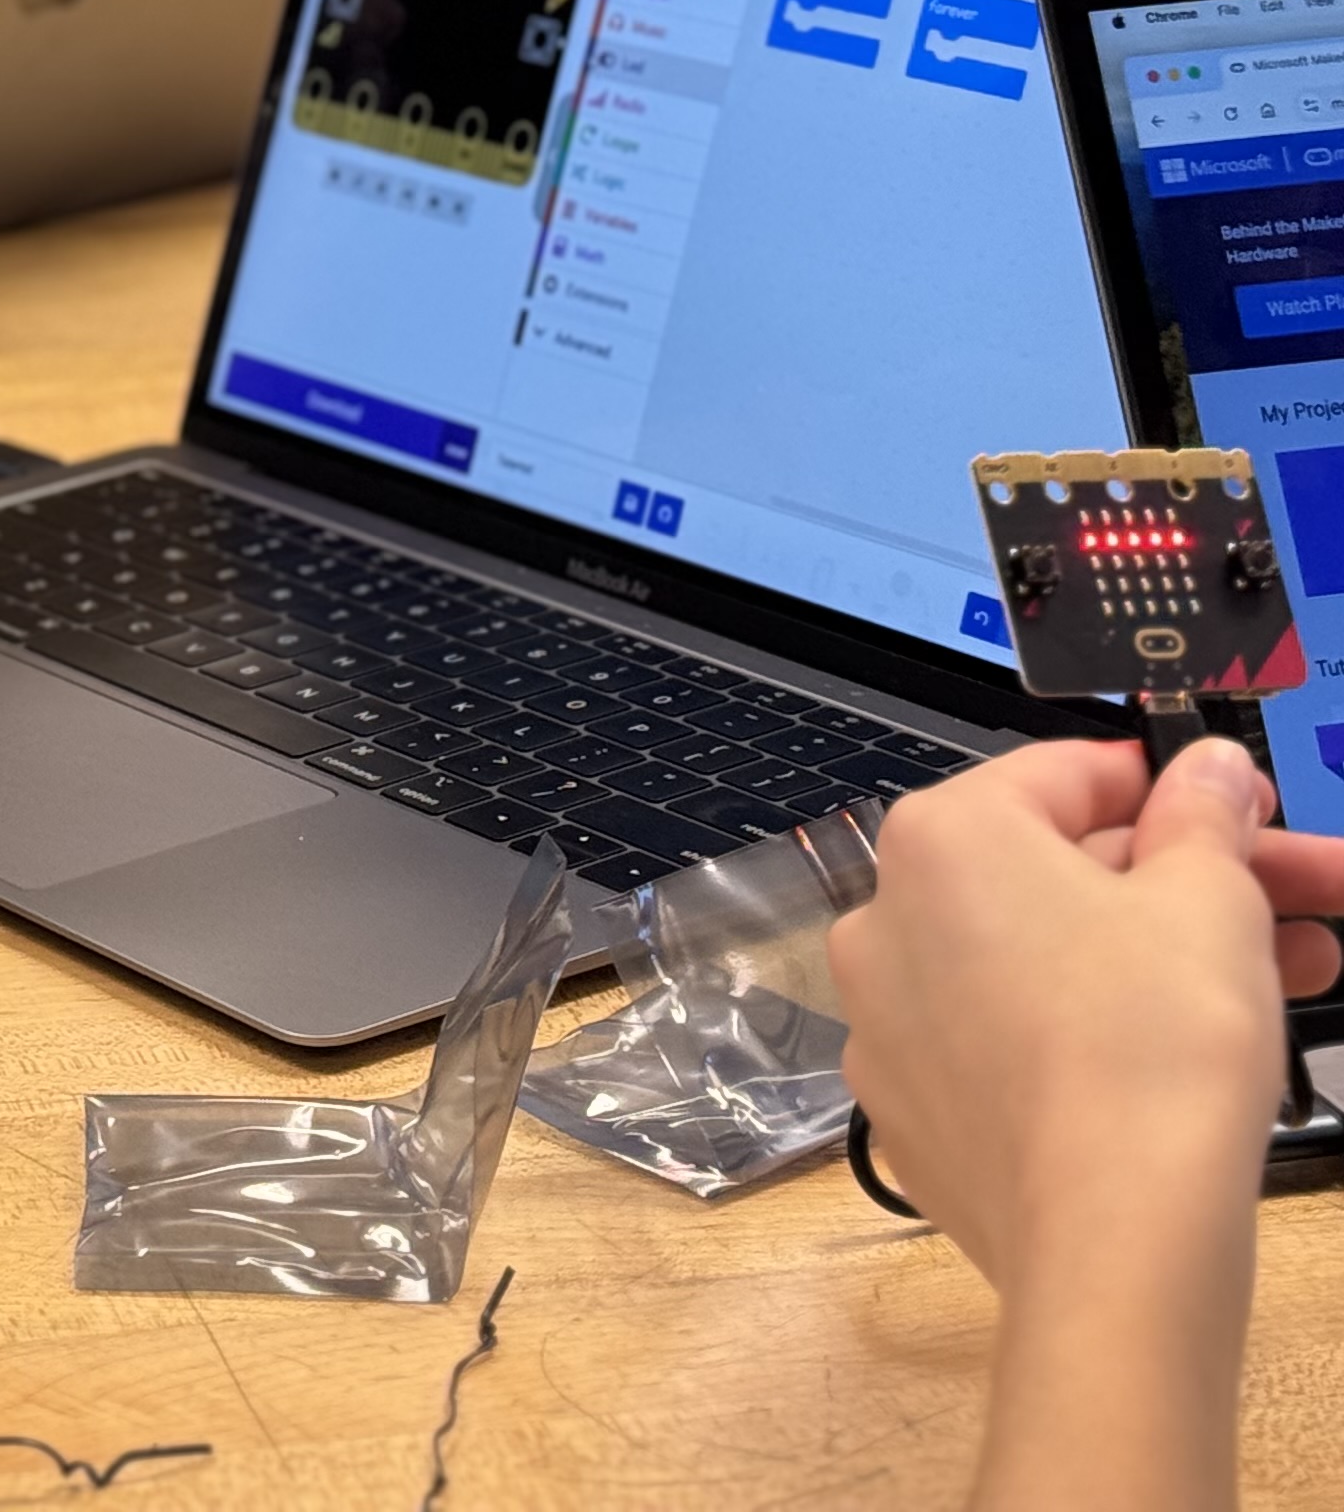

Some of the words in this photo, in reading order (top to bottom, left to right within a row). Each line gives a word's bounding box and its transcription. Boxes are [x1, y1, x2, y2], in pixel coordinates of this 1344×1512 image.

[1216, 3, 1241, 17] File
[1258, 0, 1285, 14] Edit
[1144, 8, 1200, 25] Chrome
[1252, 54, 1310, 71] Microsoft
[1191, 152, 1273, 177] Microsoft
[1220, 219, 1274, 241] Behind
[1274, 218, 1301, 236] the
[1302, 213, 1344, 233] Make
[1225, 245, 1300, 265] Hardware
[1265, 295, 1323, 318] Watch
[554, 331, 613, 360] Advanced
[1259, 404, 1290, 427] My
[441, 653, 467, 664] U
[588, 671, 610, 681] 9
[294, 687, 321, 699] N
[450, 700, 476, 713] K
[564, 698, 588, 710] O
[353, 709, 380, 723] M
[513, 725, 532, 737] L
[626, 722, 651, 733] P
[320, 755, 384, 783] command
[398, 787, 441, 807] option
